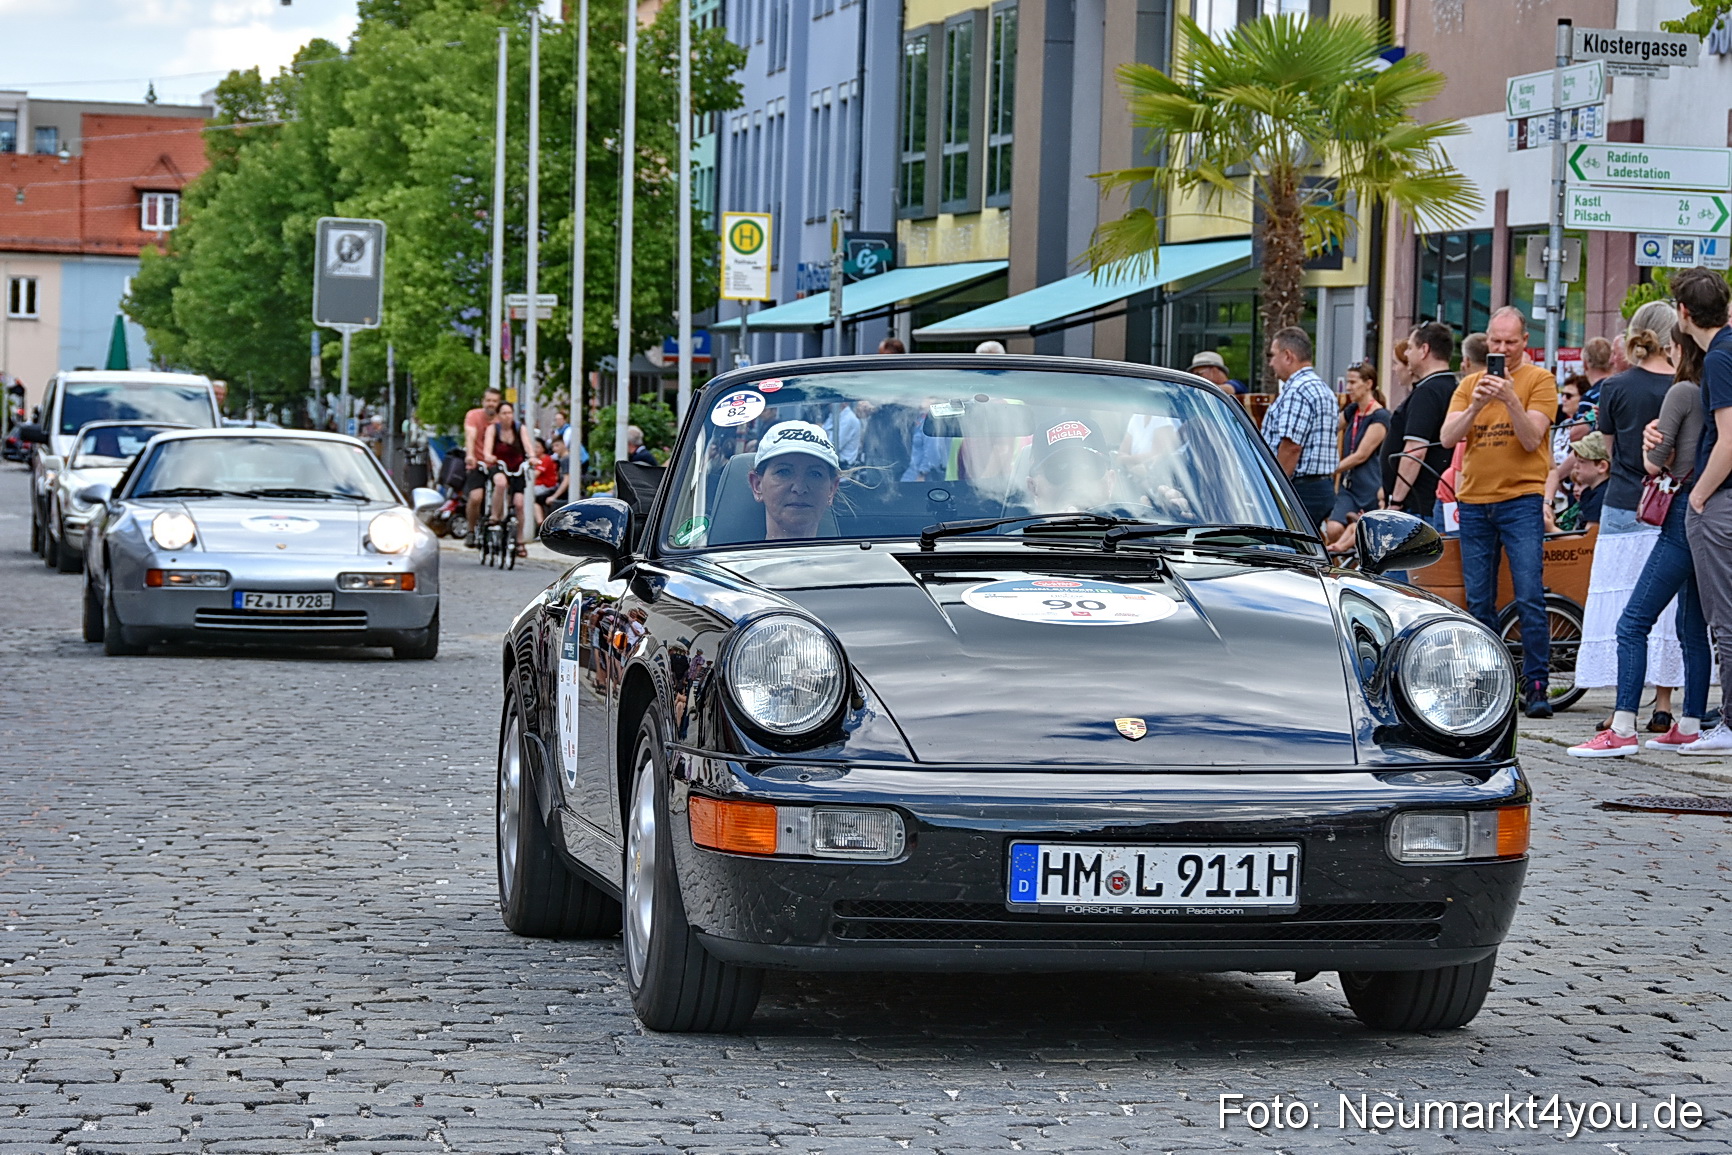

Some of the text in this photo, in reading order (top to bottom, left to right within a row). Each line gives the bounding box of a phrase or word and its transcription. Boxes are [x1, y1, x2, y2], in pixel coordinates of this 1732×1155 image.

[1584, 33, 1688, 61] Klostergasse
[1607, 151, 1649, 164] Radinfo
[1606, 166, 1671, 179] Ladestation
[1574, 194, 1690, 211] Kastl 26
[1574, 209, 1611, 222] Pilsach
[739, 227, 754, 247] H
[856, 248, 878, 275] G2
[727, 406, 747, 418] 82
[1052, 423, 1079, 434] 1000
[773, 428, 836, 451] Titleist
[1051, 431, 1082, 441] MIGLIA
[1543, 550, 1578, 561] ABBOE
[245, 594, 263, 607] FZ
[275, 595, 292, 608] IT
[297, 595, 323, 608] 928
[1042, 599, 1107, 611] 90
[1018, 851, 1295, 898] D HM L 911H
[1065, 905, 1244, 915] PORSCHE Zentrum Paderborn
